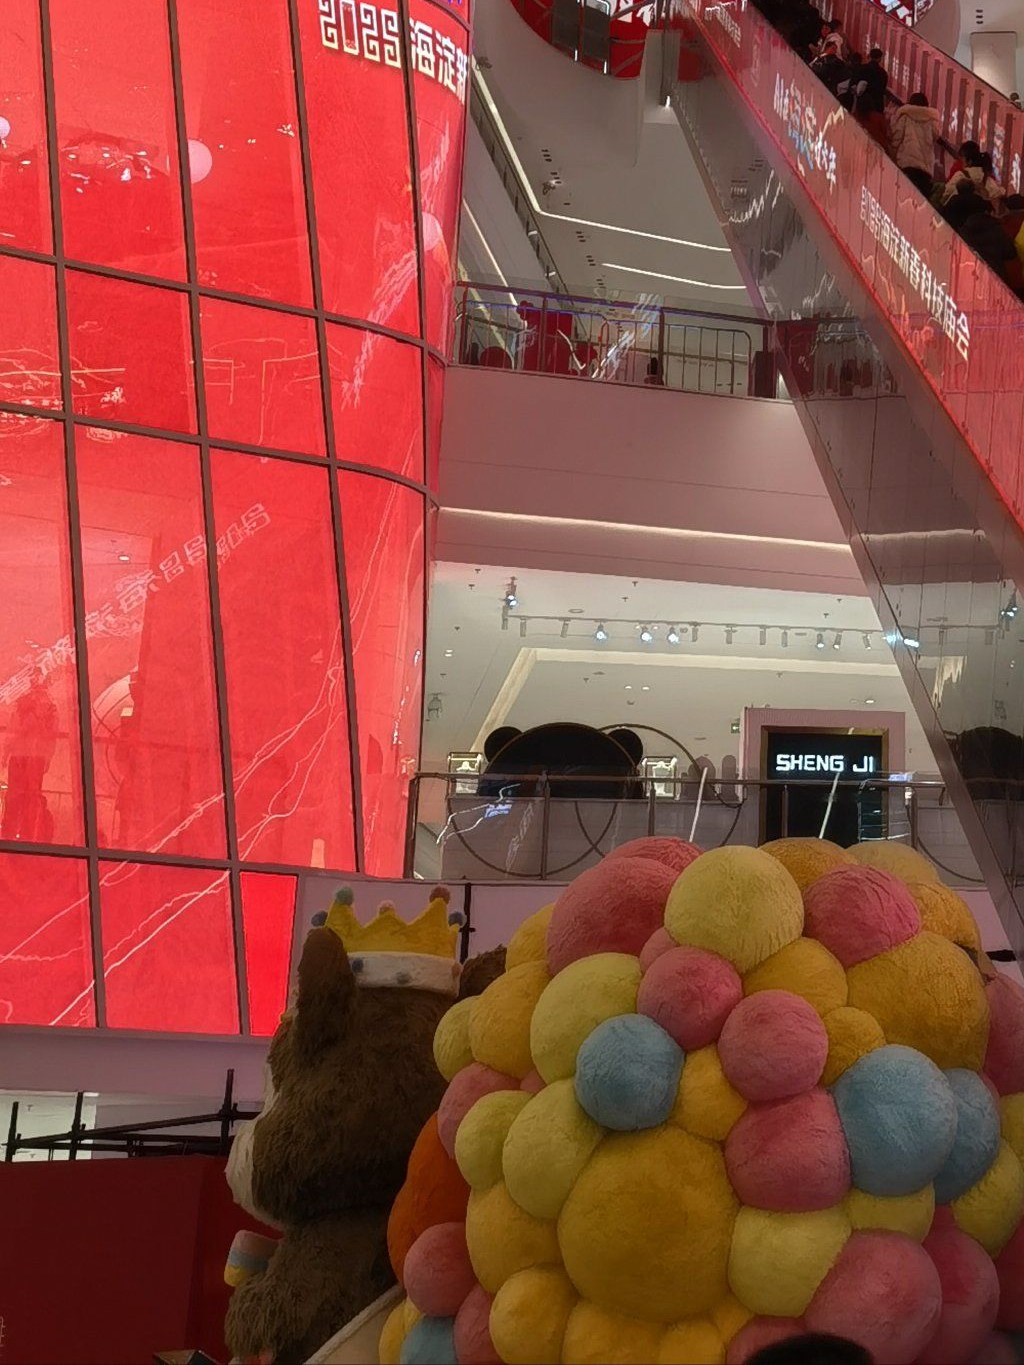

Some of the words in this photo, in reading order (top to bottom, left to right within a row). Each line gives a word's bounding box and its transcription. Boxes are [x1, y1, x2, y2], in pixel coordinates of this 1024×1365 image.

[860, 185, 971, 361] 2025海淀新春科技庙会
[775, 753, 845, 772] SHENG
[852, 755, 874, 773] JI
